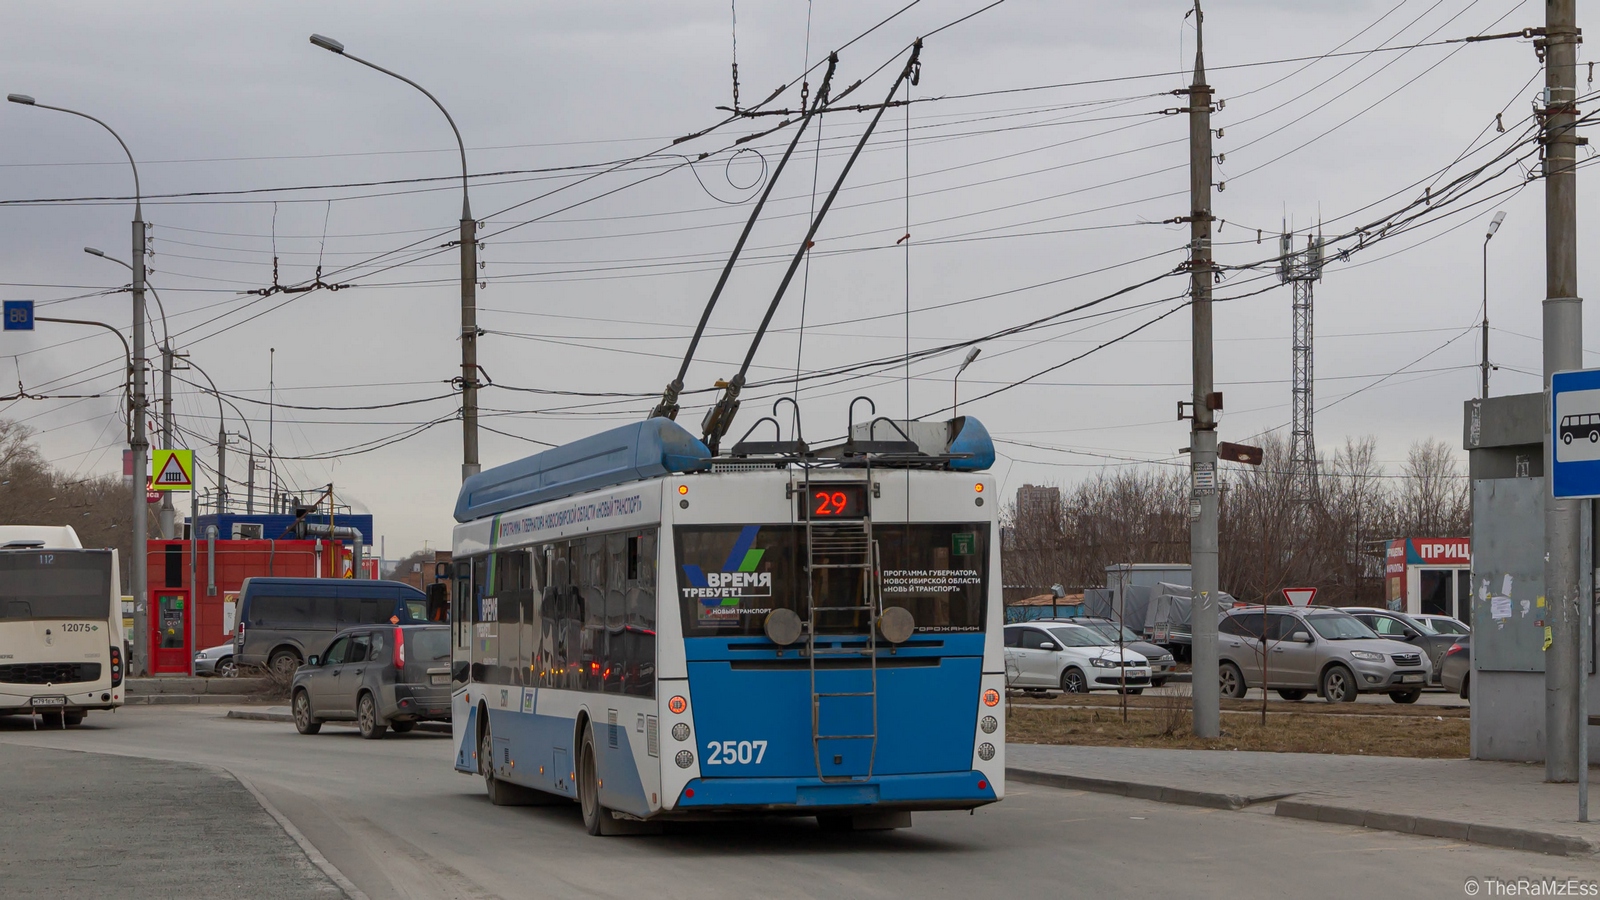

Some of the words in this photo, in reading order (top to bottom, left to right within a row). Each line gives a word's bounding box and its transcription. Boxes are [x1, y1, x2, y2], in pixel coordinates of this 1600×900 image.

[815, 491, 847, 515] 29
[1421, 543, 1469, 560] ПРИЦ
[40, 554, 54, 564] 112
[929, 569, 977, 577] ГУБЕРНАТОРА
[707, 572, 771, 587] ВРЕМЯ
[883, 577, 946, 585] НОВОСИБИРСКОЙ
[682, 588, 742, 598] ТРЕБУЕТ!
[915, 585, 961, 593] ТРАНСПОРТ»
[62, 624, 91, 632] 12075
[707, 740, 768, 765] 2507
